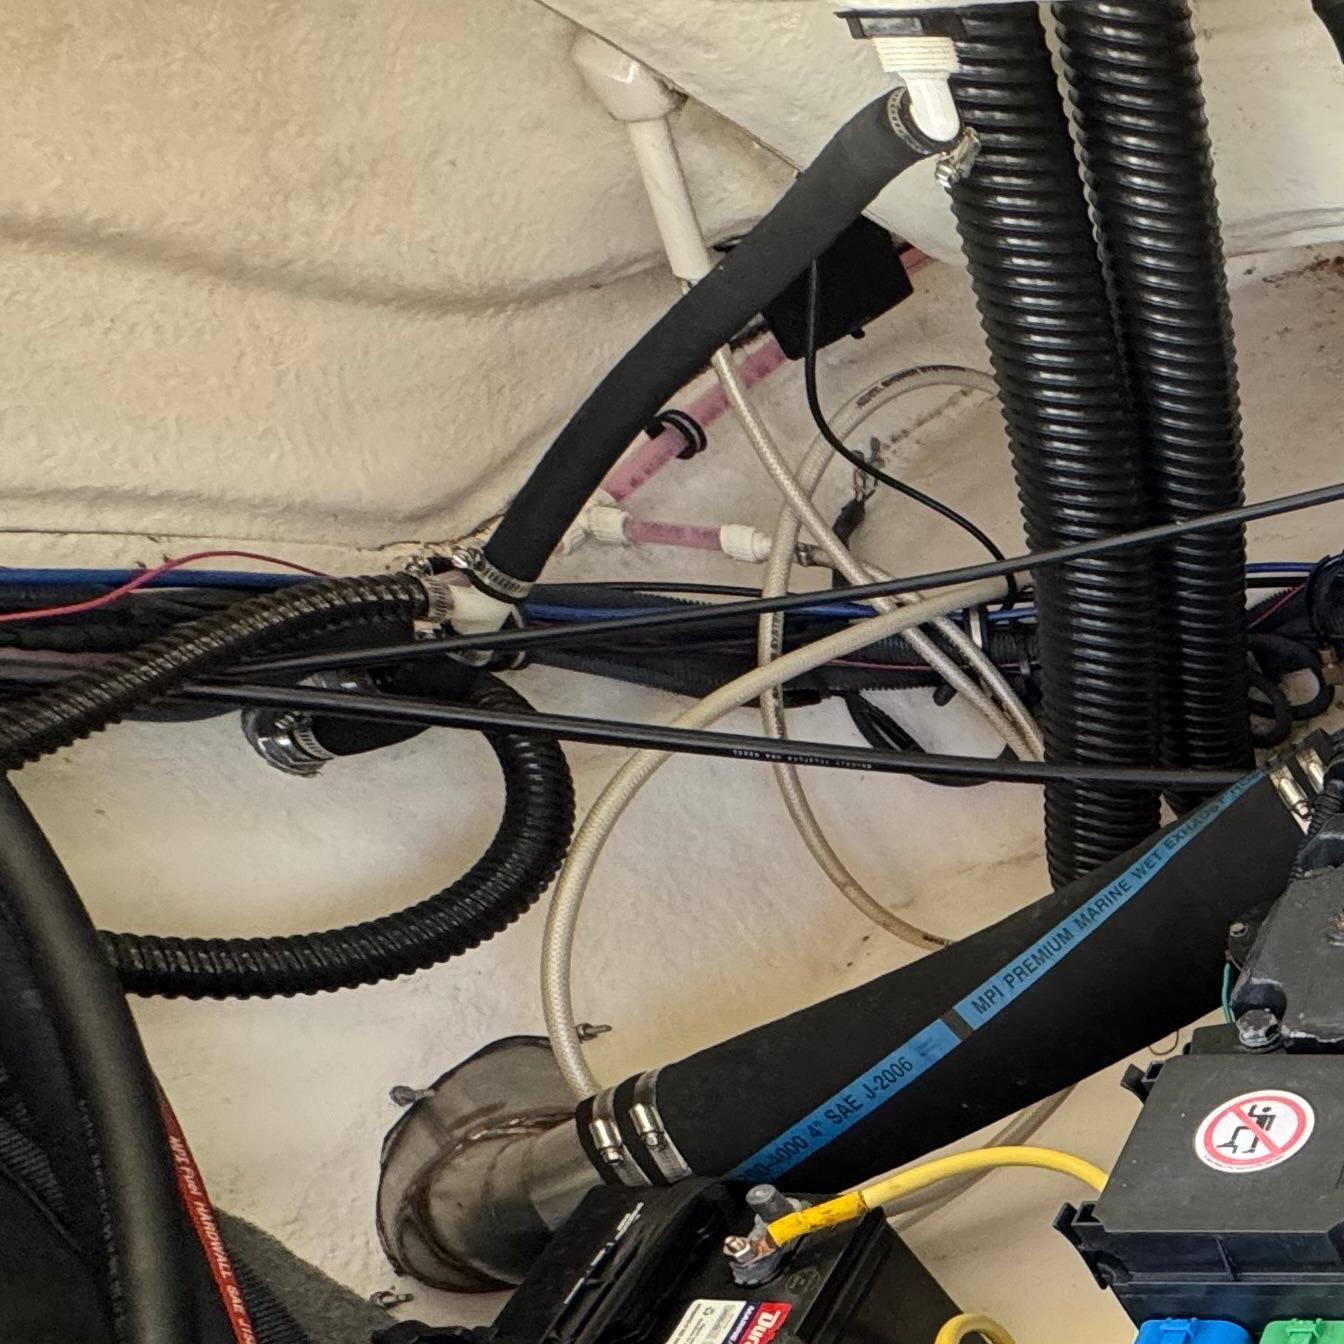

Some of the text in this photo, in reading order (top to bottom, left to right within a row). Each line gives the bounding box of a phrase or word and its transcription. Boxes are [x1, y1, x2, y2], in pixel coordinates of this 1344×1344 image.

[971, 985, 1004, 1016] MPI
[1005, 929, 1076, 990] PREMIUM
[1076, 878, 1133, 931] MARINE
[1132, 850, 1163, 882] WET
[1163, 794, 1231, 851] EXHAUST
[827, 1094, 864, 1126] SAE
[863, 1056, 914, 1101] J-2006
[178, 1162, 203, 1197] Fuel
[192, 1197, 234, 1279] HARDWALL
[225, 1281, 246, 1315] SAE
